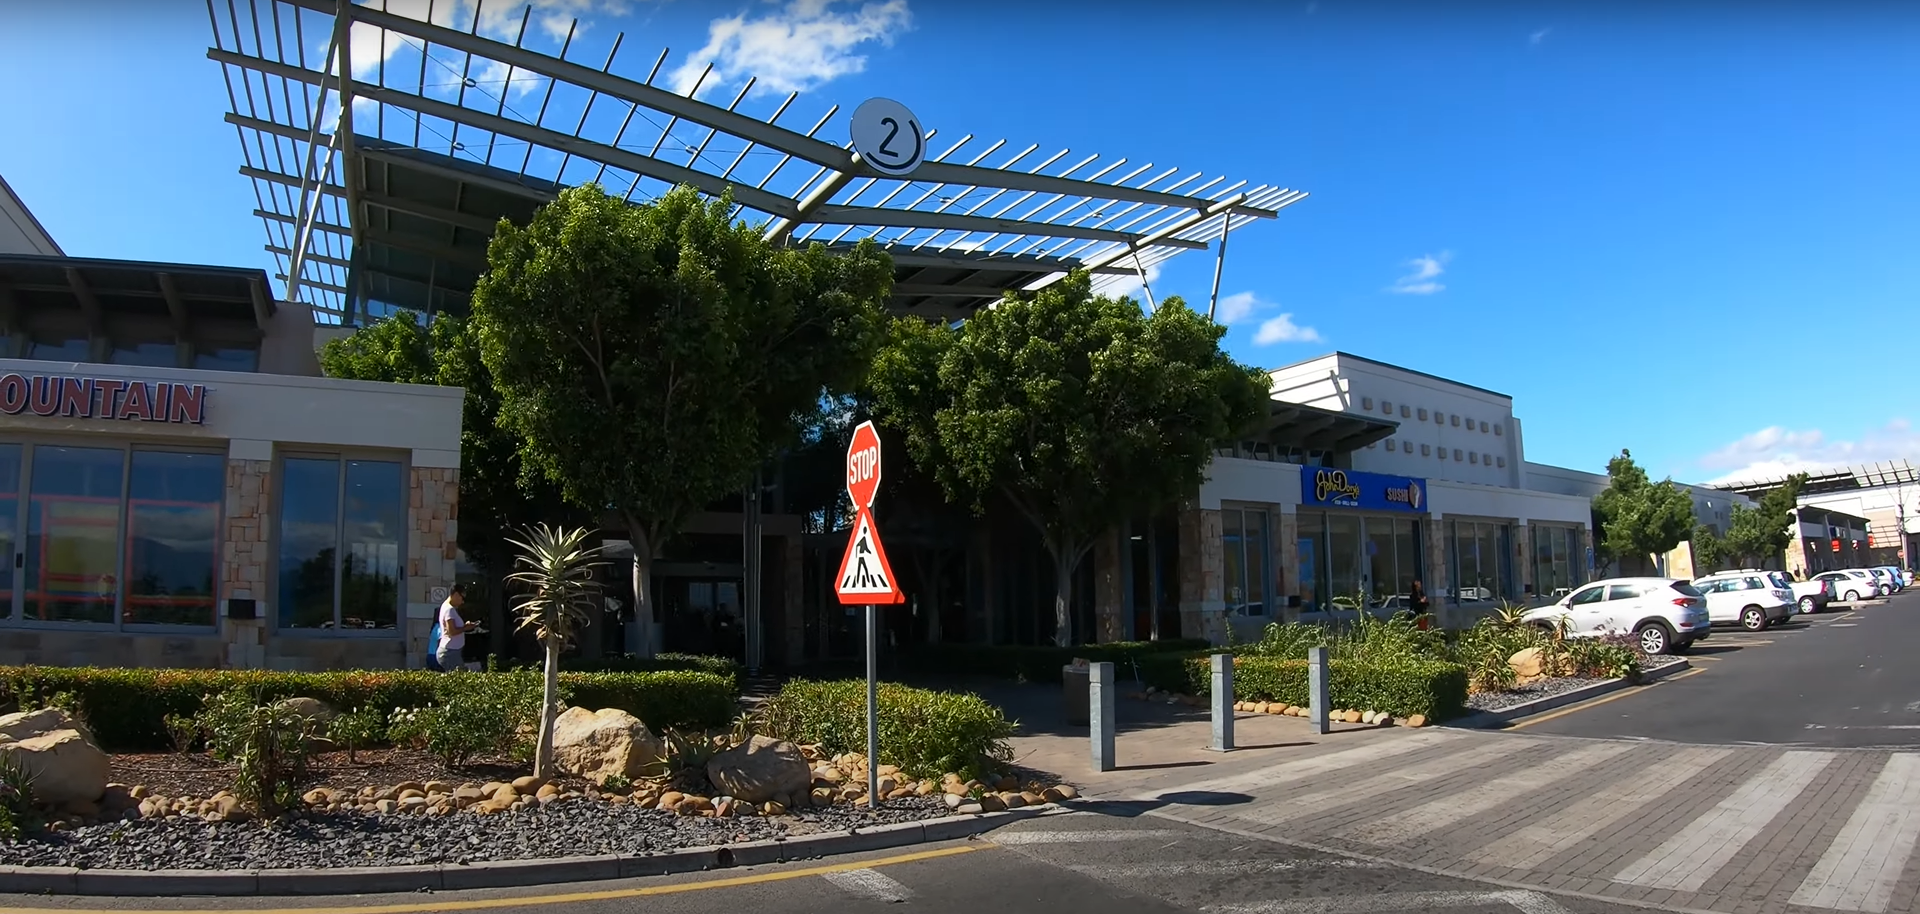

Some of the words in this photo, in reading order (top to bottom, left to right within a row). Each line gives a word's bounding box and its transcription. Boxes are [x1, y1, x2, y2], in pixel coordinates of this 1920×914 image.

[879, 117, 899, 157] 2
[850, 446, 877, 485] STOP
[1387, 487, 1409, 502] SUSHI
